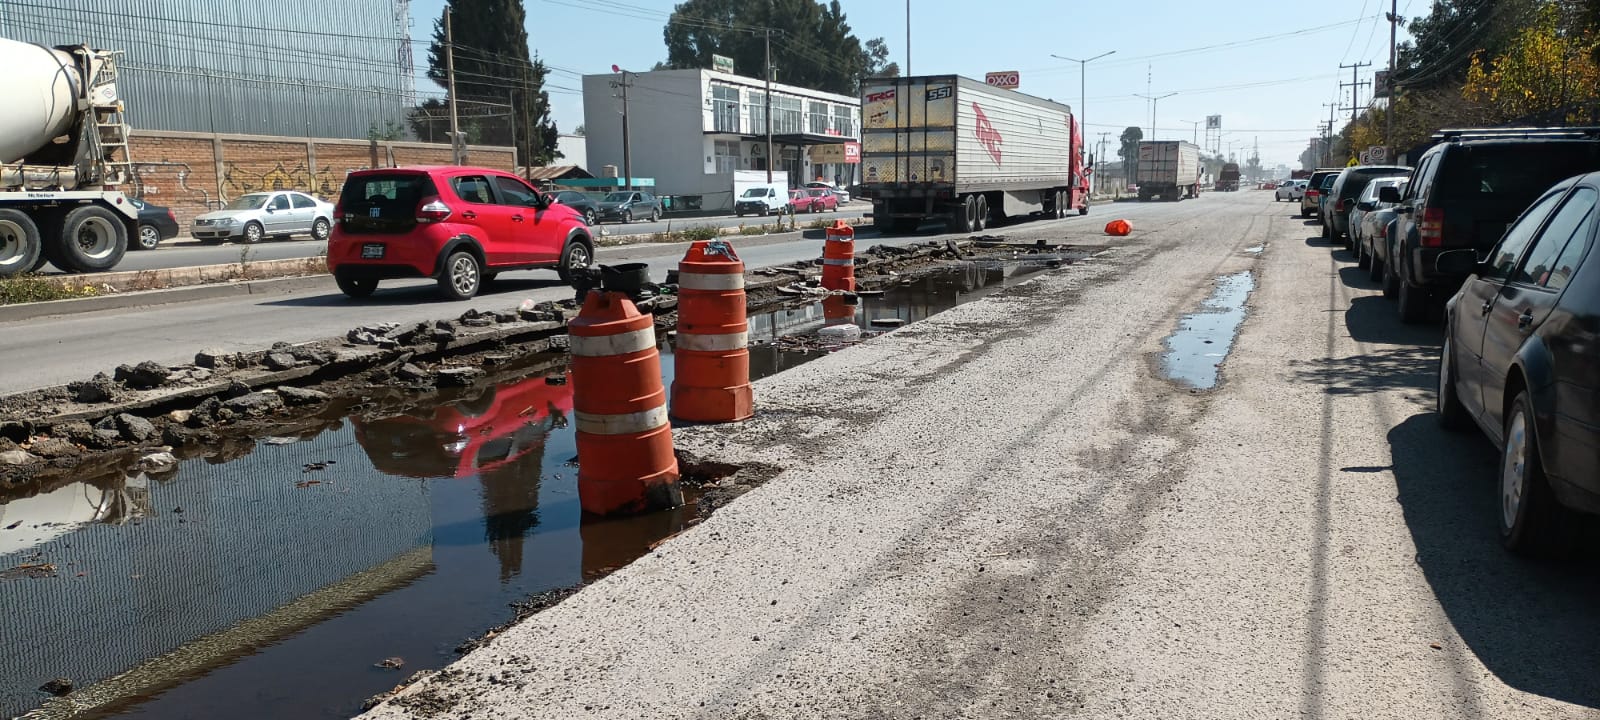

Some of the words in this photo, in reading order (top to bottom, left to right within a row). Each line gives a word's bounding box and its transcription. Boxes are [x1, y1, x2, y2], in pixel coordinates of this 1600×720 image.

[987, 74, 1017, 87] OXXO
[866, 90, 895, 102] TRG
[370, 207, 380, 218] FIAT
